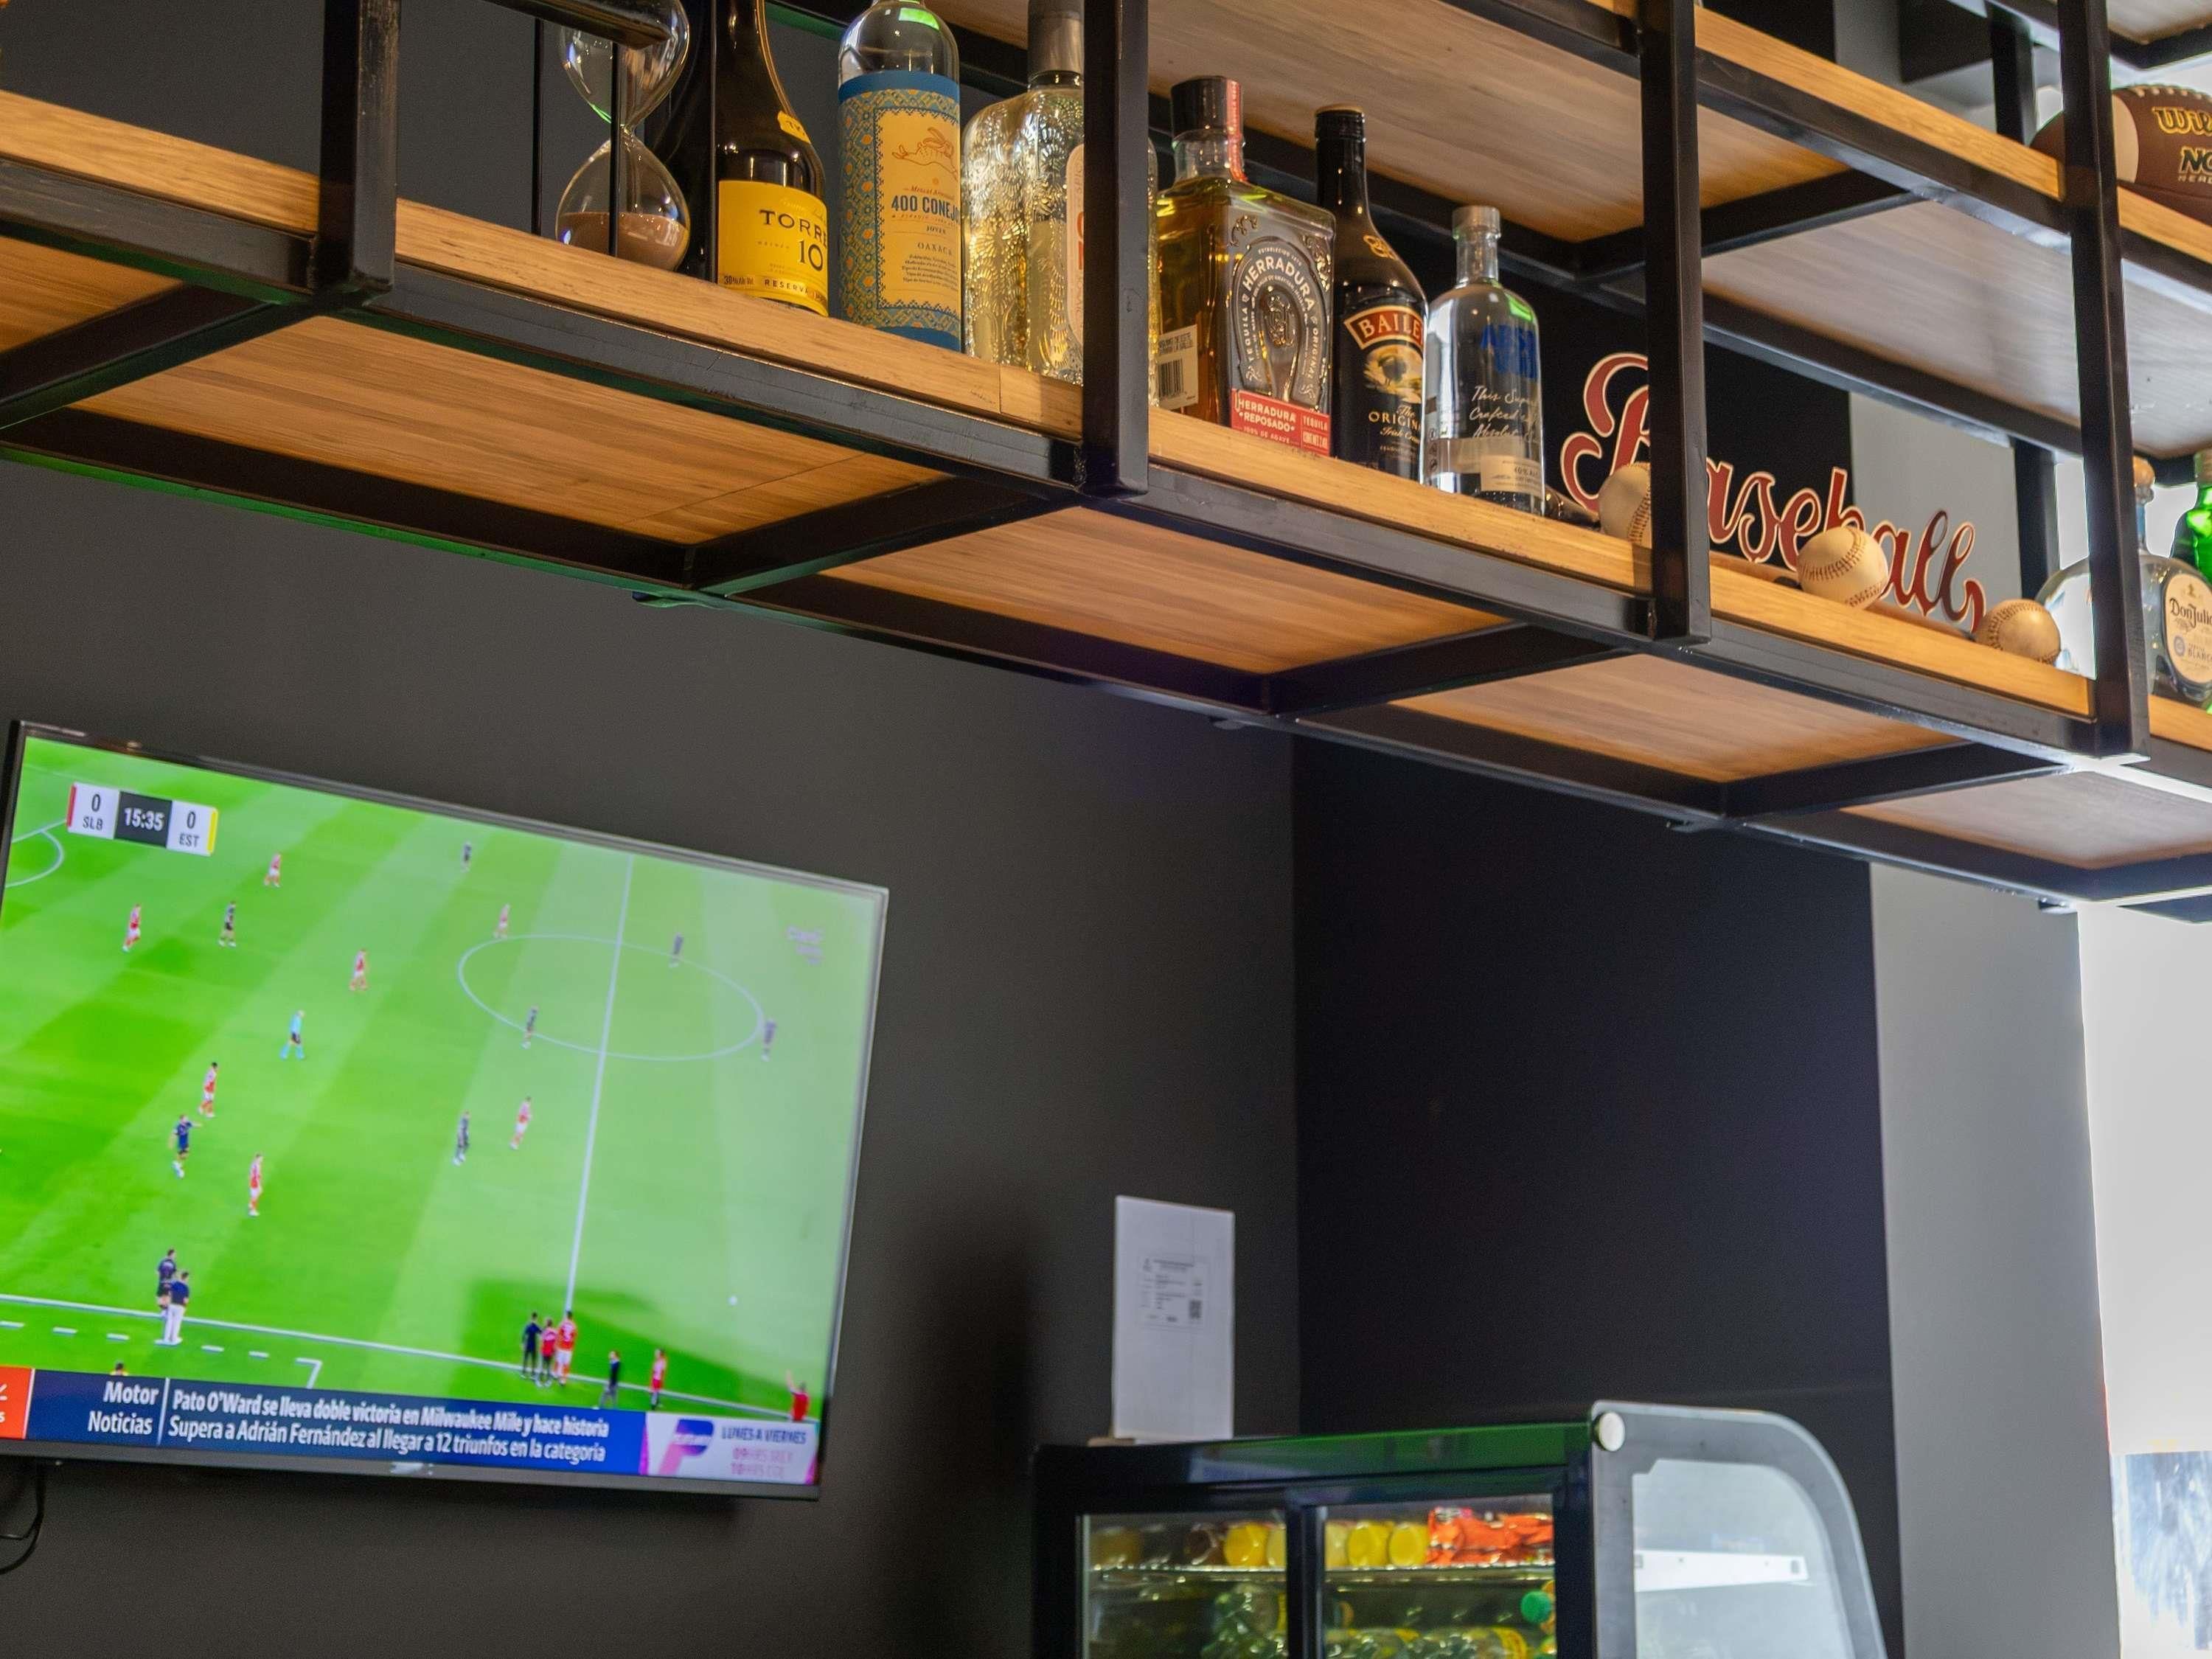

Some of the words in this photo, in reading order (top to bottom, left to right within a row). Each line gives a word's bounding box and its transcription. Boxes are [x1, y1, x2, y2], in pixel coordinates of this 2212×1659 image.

[891, 195, 917, 212] 400
[799, 239, 824, 272] 10
[1242, 256, 1316, 311] HERRADURA
[1242, 307, 1256, 363] TEQUILA
[1306, 327, 1319, 379] ORIGINAL
[1238, 398, 1296, 423] HERRADURA
[1243, 411, 1291, 433] REPOSADO
[2169, 597, 2191, 618] Don
[91, 793, 101, 813] 0
[83, 816, 103, 831] SLB
[124, 807, 165, 832] 15:35
[187, 811, 196, 830] 0
[179, 832, 200, 848] EST
[103, 1381, 159, 1405] Motor
[88, 1411, 153, 1435] Noticias
[173, 1389, 204, 1412] Pato
[262, 1401, 278, 1416] se
[279, 1396, 311, 1419] lleva
[313, 1398, 351, 1422] doble
[352, 1401, 400, 1424] victoria
[403, 1409, 420, 1426] en
[420, 1405, 492, 1431] Milwaukee
[521, 1416, 534, 1438] y
[533, 1413, 562, 1436] hace
[562, 1414, 611, 1438] historia
[168, 1414, 223, 1442] Supera
[225, 1424, 237, 1436] a
[236, 1419, 287, 1444] Adrián
[289, 1422, 365, 1448] Fernández
[366, 1427, 383, 1449] al
[383, 1427, 423, 1455] llegar
[424, 1436, 434, 1452] a
[436, 1430, 453, 1453] 12
[453, 1434, 509, 1457] triunfos
[509, 1441, 529, 1458] en
[529, 1438, 543, 1459] la
